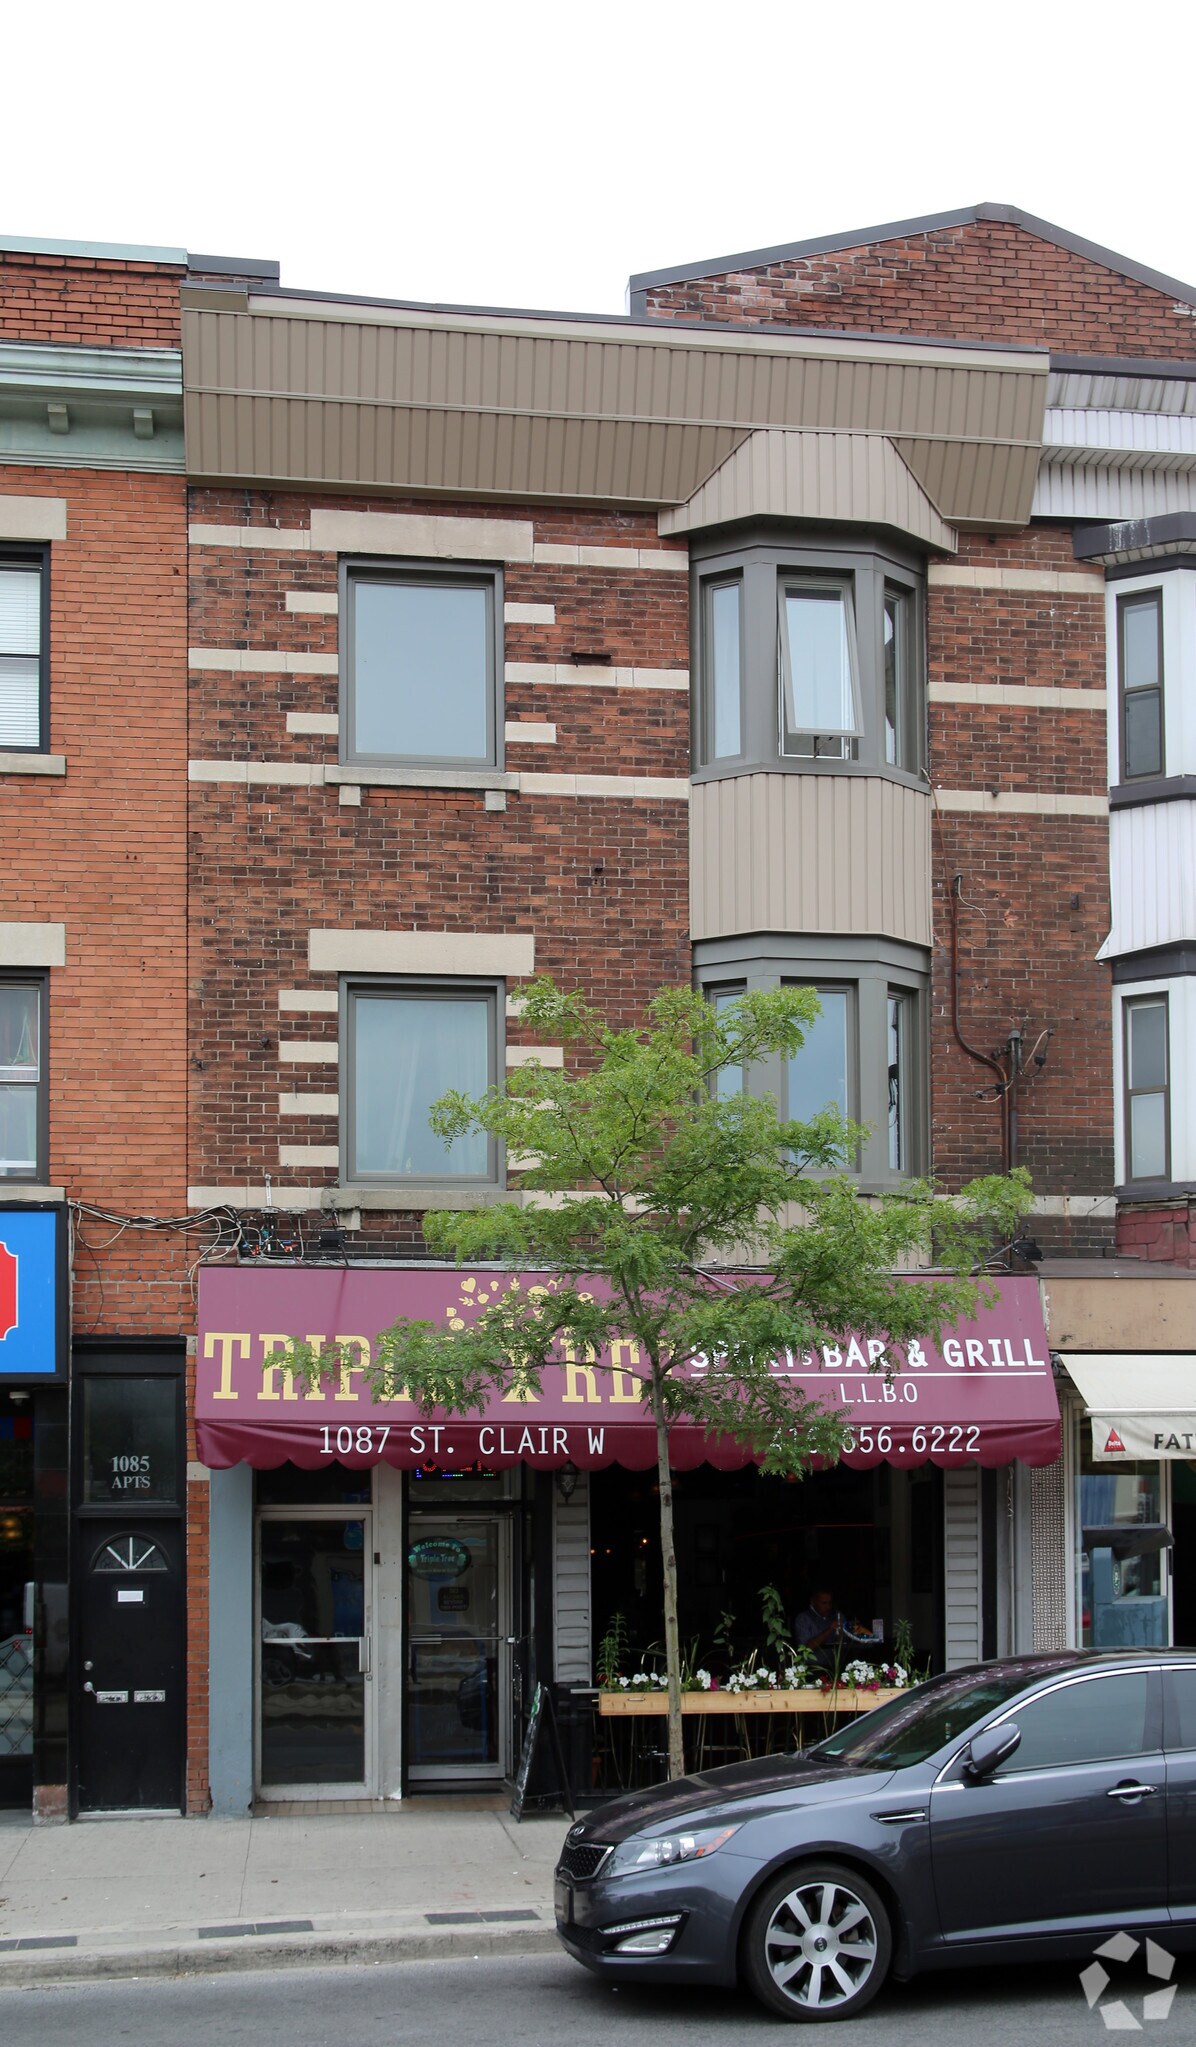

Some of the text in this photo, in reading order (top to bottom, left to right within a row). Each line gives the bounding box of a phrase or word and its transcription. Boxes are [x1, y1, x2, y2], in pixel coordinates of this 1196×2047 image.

[822, 1336, 891, 1368] BAR
[898, 1338, 928, 1367] &
[943, 1338, 1045, 1367] GRILL
[204, 1332, 456, 1401] TRIPL
[840, 1382, 918, 1403] L.L.B.O
[319, 1426, 605, 1455] 1087 ST. CLAIR W
[1153, 1433, 1196, 1450] FAT
[111, 1455, 150, 1472] 1085
[111, 1475, 151, 1489] APTS
[412, 1541, 450, 1553] Welcome
